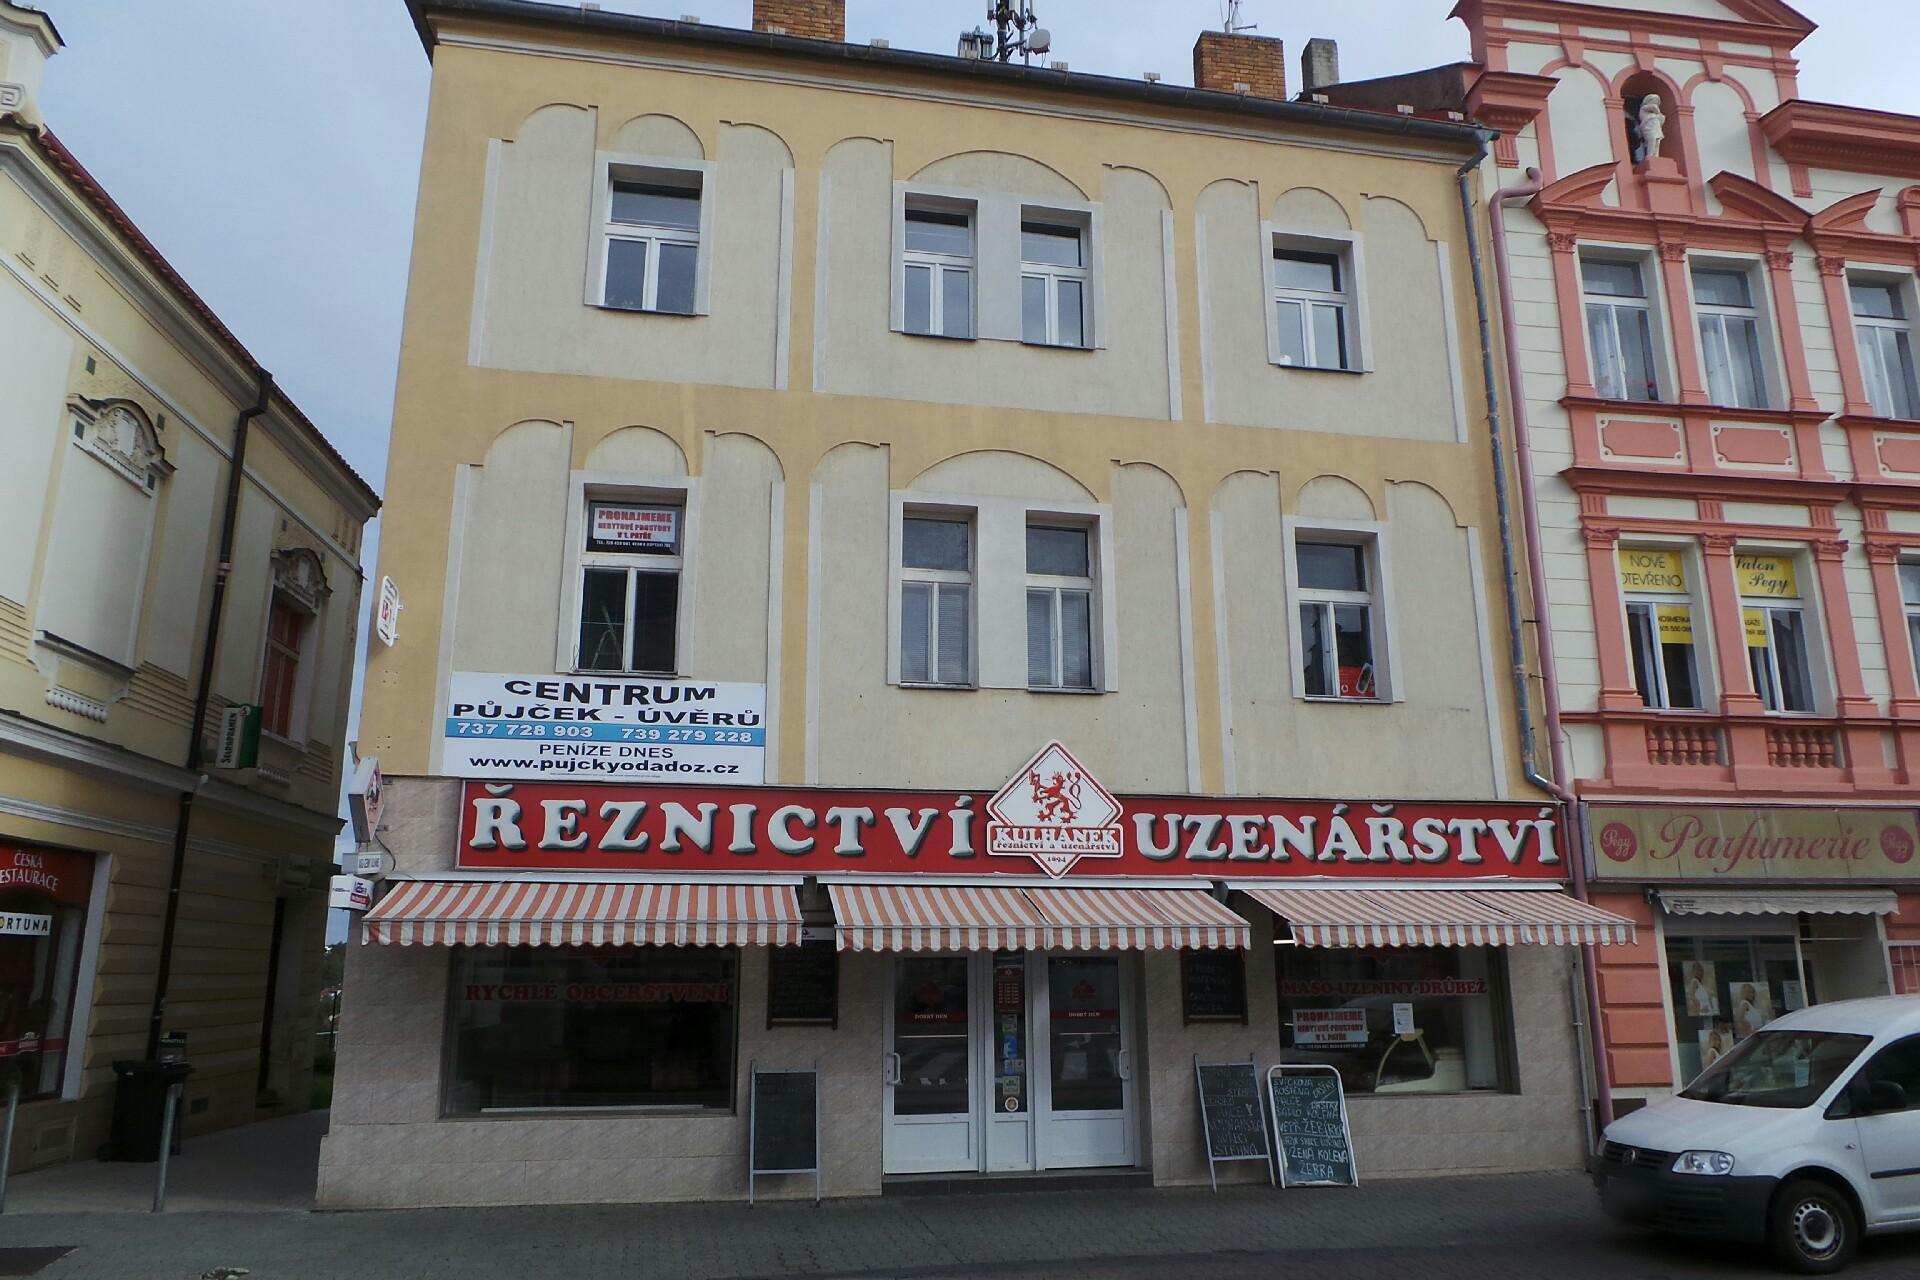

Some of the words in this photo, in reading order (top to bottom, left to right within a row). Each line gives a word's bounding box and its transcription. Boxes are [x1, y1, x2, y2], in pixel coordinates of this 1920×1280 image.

[504, 680, 716, 706] CENTRUM
[453, 700, 603, 721] PŮJČEK
[637, 707, 760, 726] ÚVĚRŮ
[457, 722, 499, 734] 737
[506, 724, 547, 736] 728
[553, 726, 593, 737] 903
[621, 728, 661, 740] 739
[668, 730, 707, 741] 279
[714, 731, 752, 743] 228
[539, 743, 612, 756] PENÍZE
[619, 747, 674, 758] DNES
[469, 758, 740, 774] www.pujckyodadoz.cz
[469, 783, 976, 858] ŘEZNICTVÍ
[1132, 803, 1561, 864] UZENÁŘSTVÍ
[1650, 814, 1872, 873] Parfumerie
